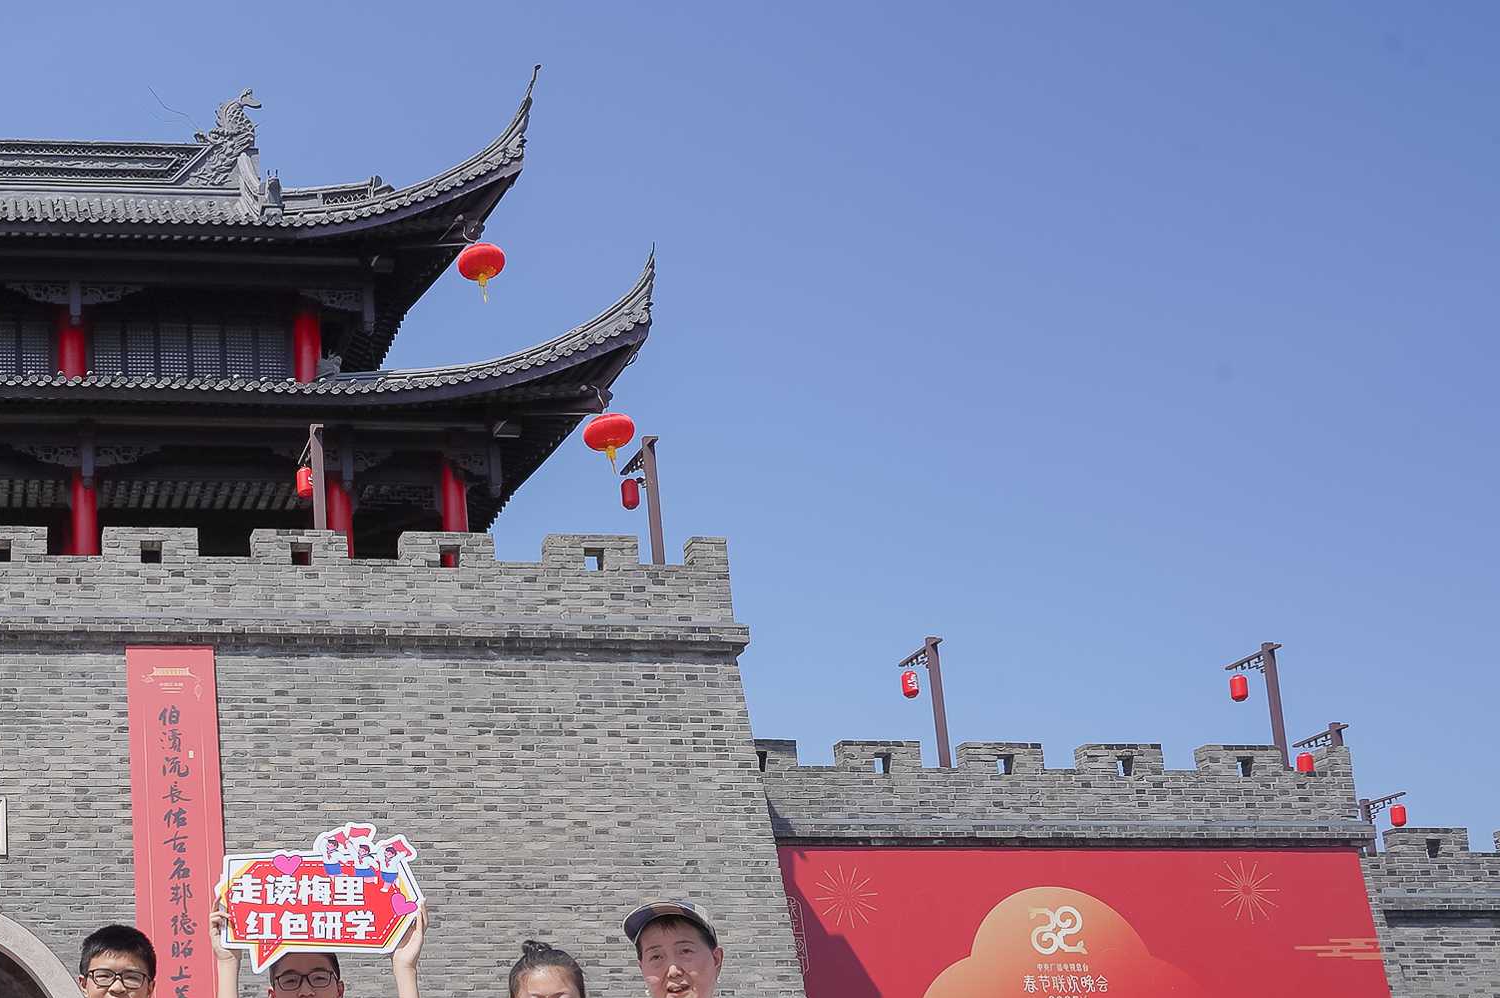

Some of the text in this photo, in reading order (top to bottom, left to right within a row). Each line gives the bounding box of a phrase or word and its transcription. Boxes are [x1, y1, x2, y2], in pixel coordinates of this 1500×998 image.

[230, 873, 365, 906] 走读梅里
[244, 910, 376, 940] 红色研学
[1023, 974, 1109, 994] 春节联欢晚会
